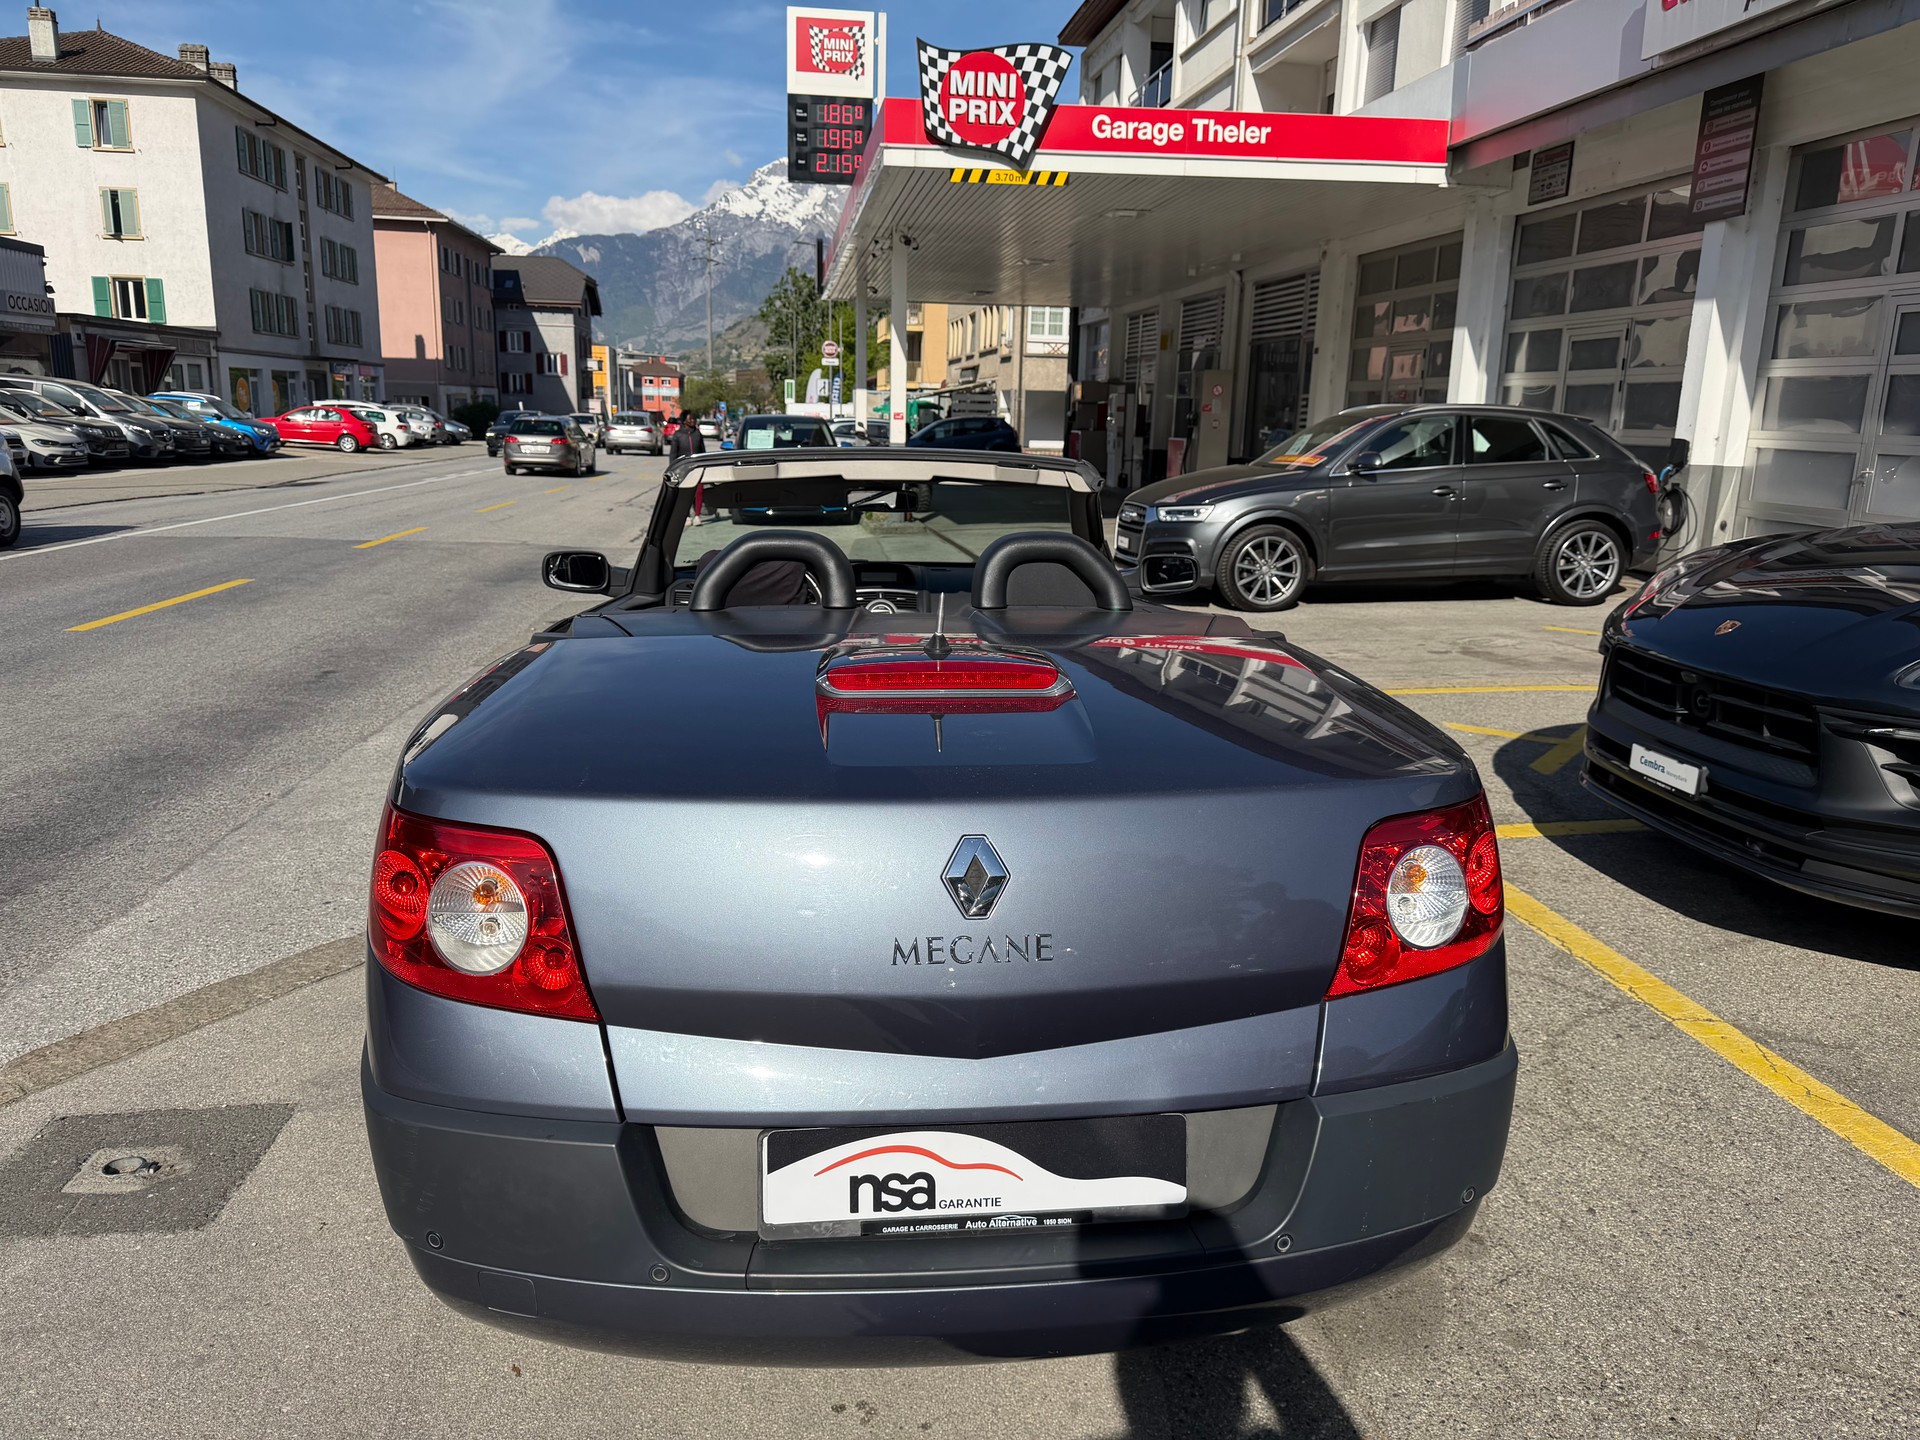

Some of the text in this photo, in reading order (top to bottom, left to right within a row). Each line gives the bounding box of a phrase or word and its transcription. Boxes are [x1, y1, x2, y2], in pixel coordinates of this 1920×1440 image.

[823, 37, 854, 51] MINI
[823, 50, 854, 63] PRIX
[949, 70, 1018, 99] MINI
[949, 98, 1017, 126] PRIX
[1091, 114, 1272, 147] Garage Theler
[8, 294, 55, 314] OCCASION
[1639, 755, 1665, 774] Cembra
[891, 933, 1055, 966] MEGANE
[849, 1171, 1002, 1214] nsa GARANTIE
[882, 1225, 909, 1234] GARAGE
[915, 1223, 959, 1232] CARROSSERIE
[965, 1220, 987, 1230] Auto
[988, 1216, 1038, 1229] Alternative
[1043, 1218, 1057, 1226] 1950
[1057, 1217, 1072, 1225] SION
